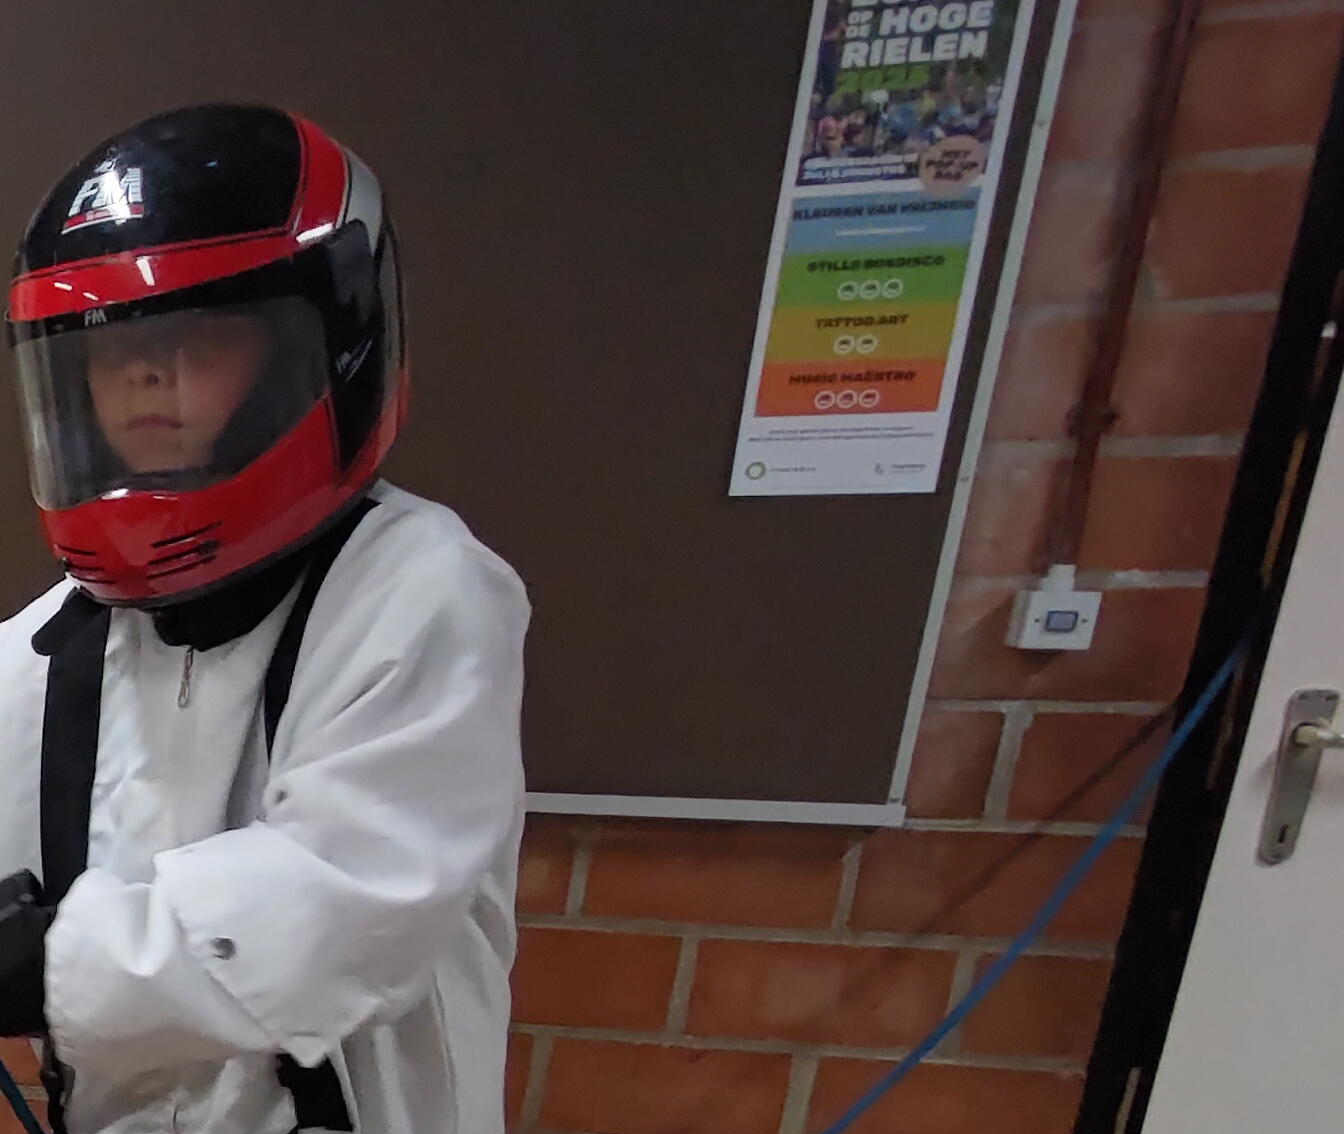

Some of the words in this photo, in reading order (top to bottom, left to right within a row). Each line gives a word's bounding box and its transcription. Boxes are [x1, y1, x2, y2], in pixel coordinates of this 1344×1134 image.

[847, 10, 874, 25] OP
[879, 2, 995, 35] HOGE
[841, 30, 989, 69] RIELEN
[867, 203, 898, 216] VAN
[84, 307, 108, 328] FM
